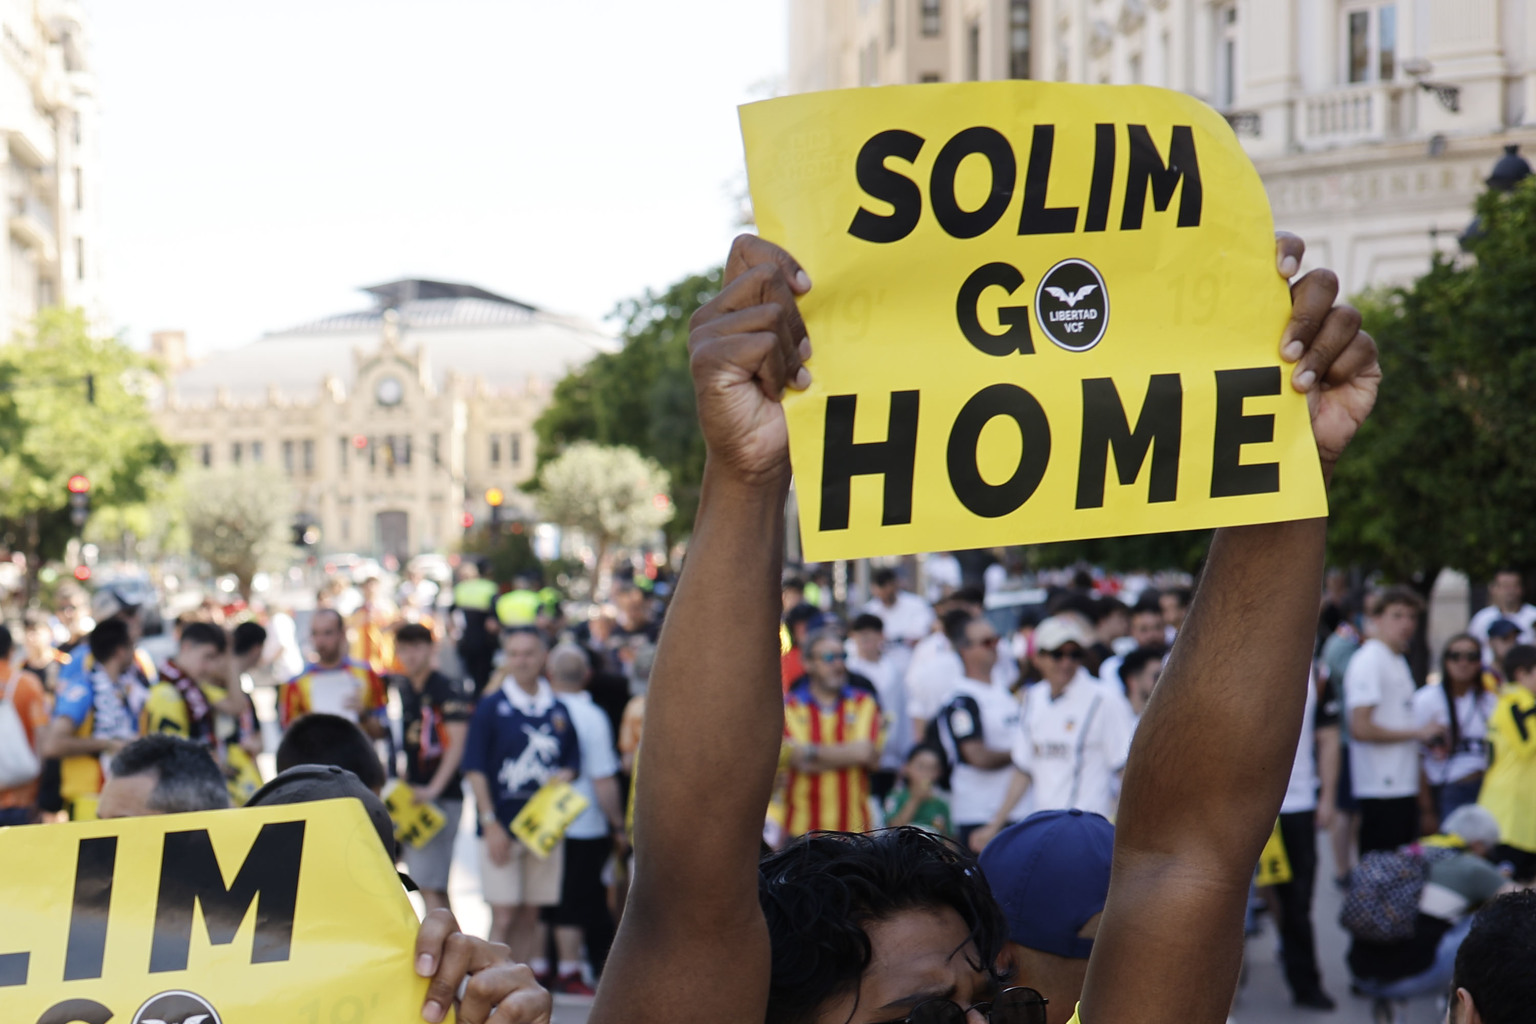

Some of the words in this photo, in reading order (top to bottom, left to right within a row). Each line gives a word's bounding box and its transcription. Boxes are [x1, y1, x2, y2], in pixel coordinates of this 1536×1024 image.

[848, 124, 1202, 243] SOLIM
[1049, 309, 1098, 322] LIBERTAD
[1064, 322, 1084, 333] VCF
[819, 366, 1281, 531] HOME
